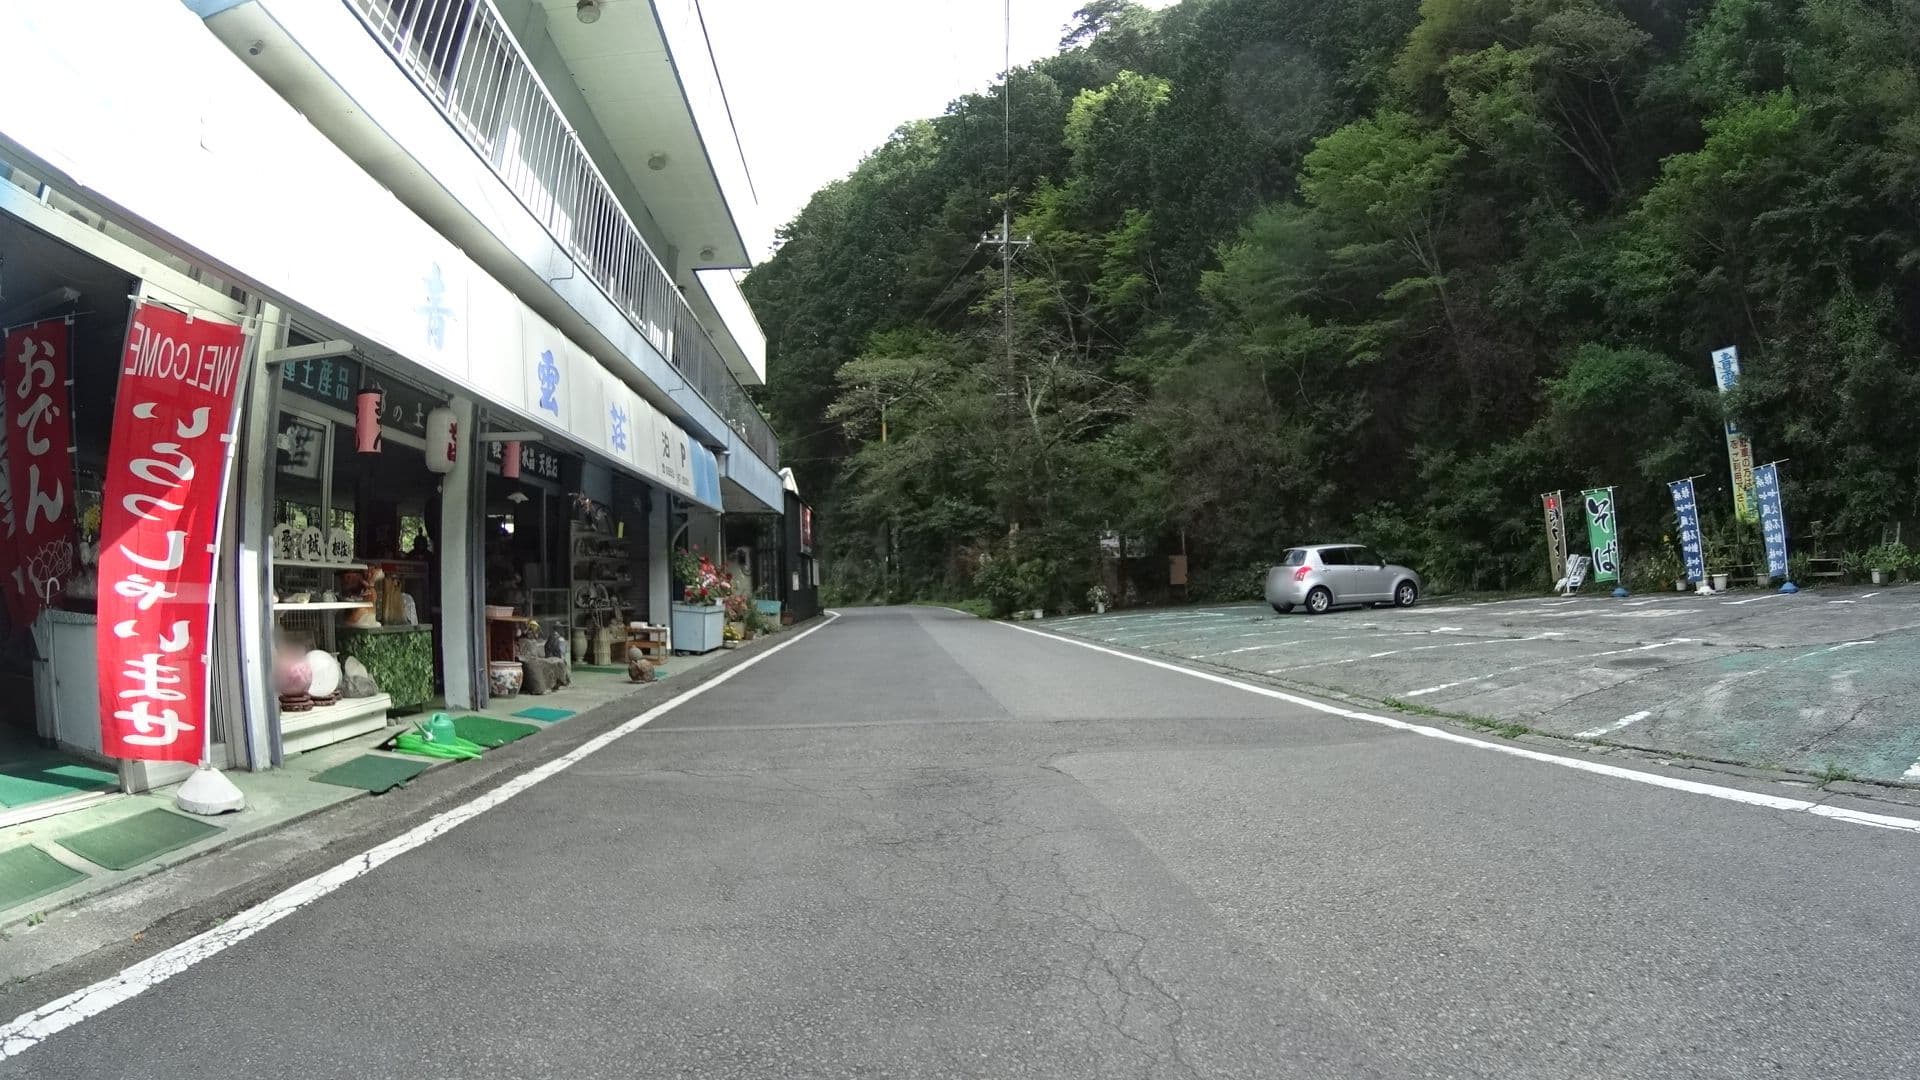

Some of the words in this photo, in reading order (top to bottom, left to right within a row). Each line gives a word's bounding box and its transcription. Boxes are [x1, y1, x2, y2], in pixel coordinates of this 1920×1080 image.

[17, 336, 63, 534] おでん
[1586, 497, 1617, 574] そば
